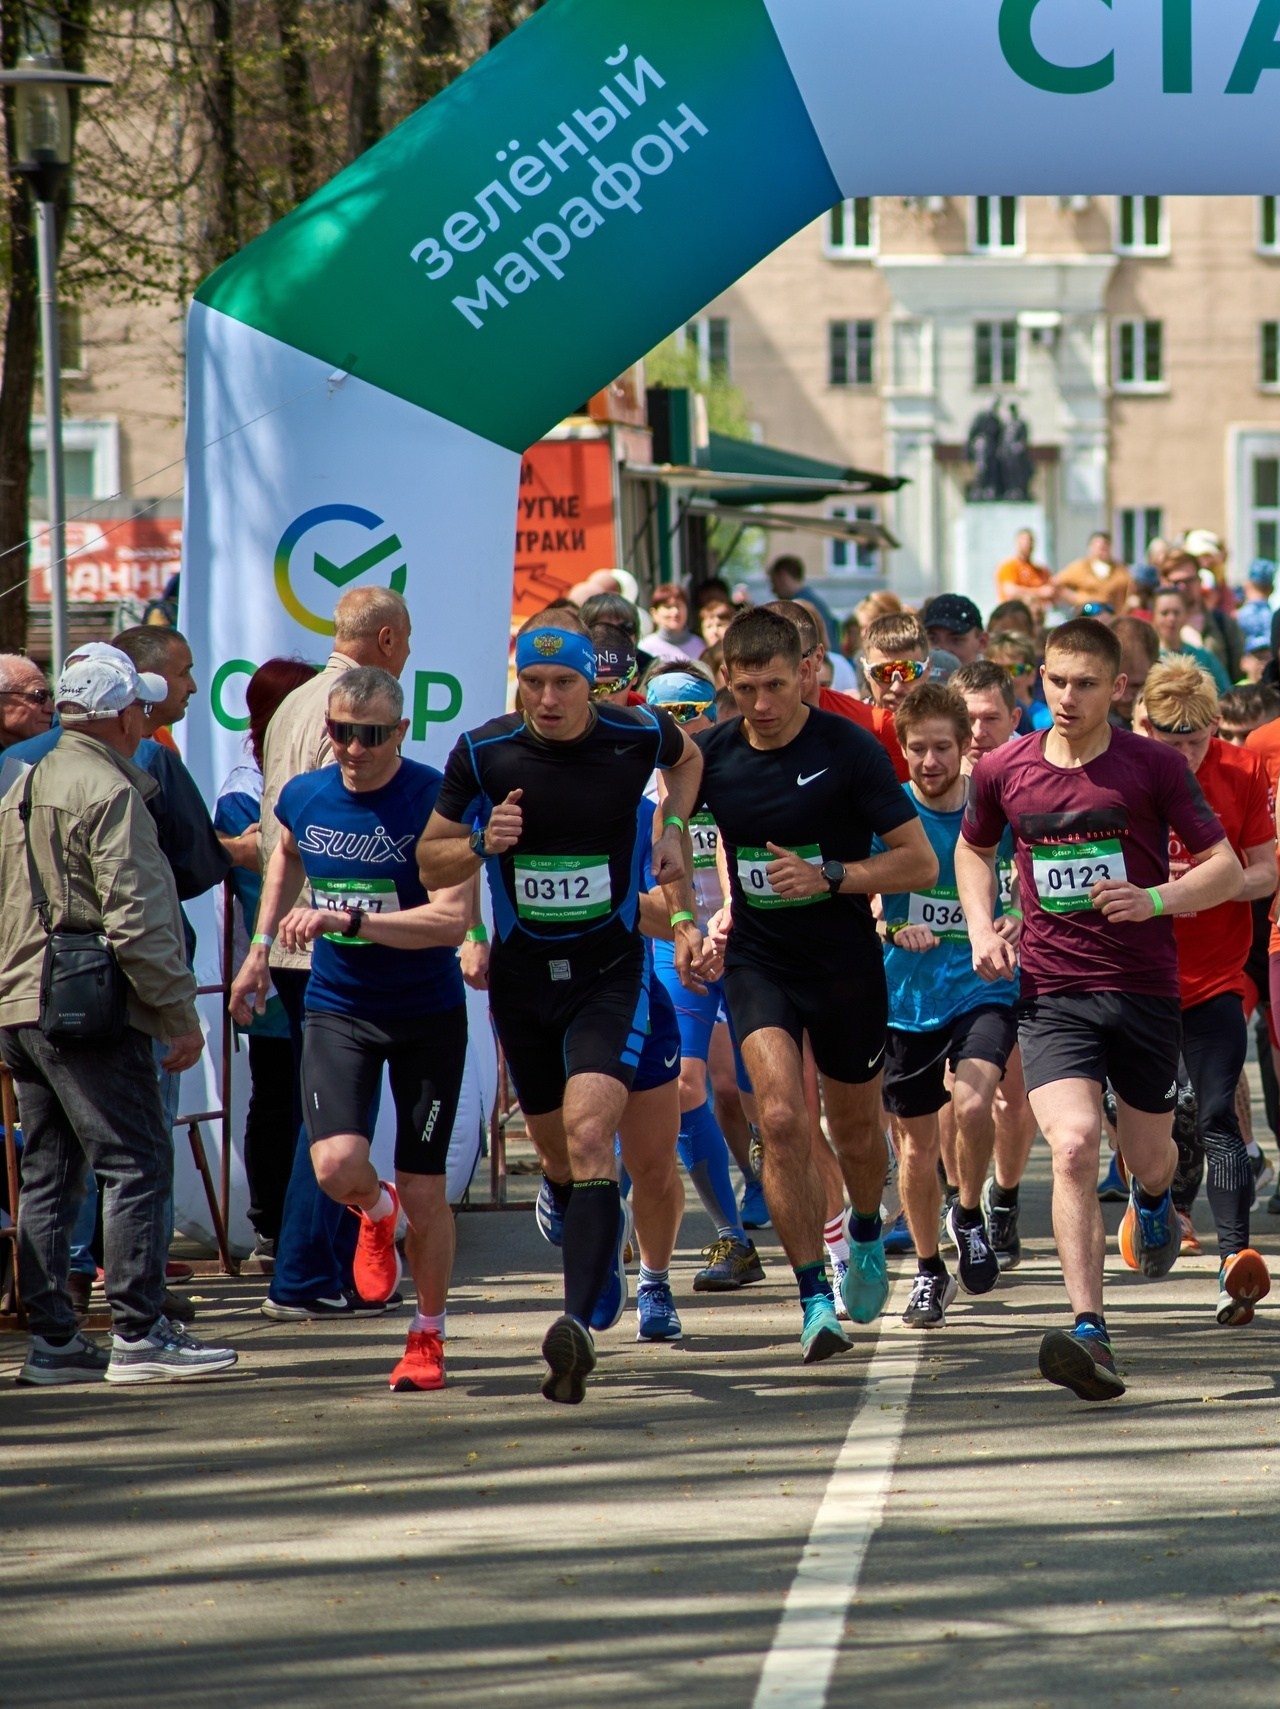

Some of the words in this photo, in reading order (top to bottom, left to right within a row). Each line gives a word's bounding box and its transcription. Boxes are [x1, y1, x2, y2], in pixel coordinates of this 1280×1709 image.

[409, 44, 667, 280] зелёный
[452, 103, 708, 329] марафон
[211, 659, 462, 741] СР
[524, 875, 590, 900] 0312
[1048, 864, 1111, 890] 0123
[922, 903, 968, 925] 036
